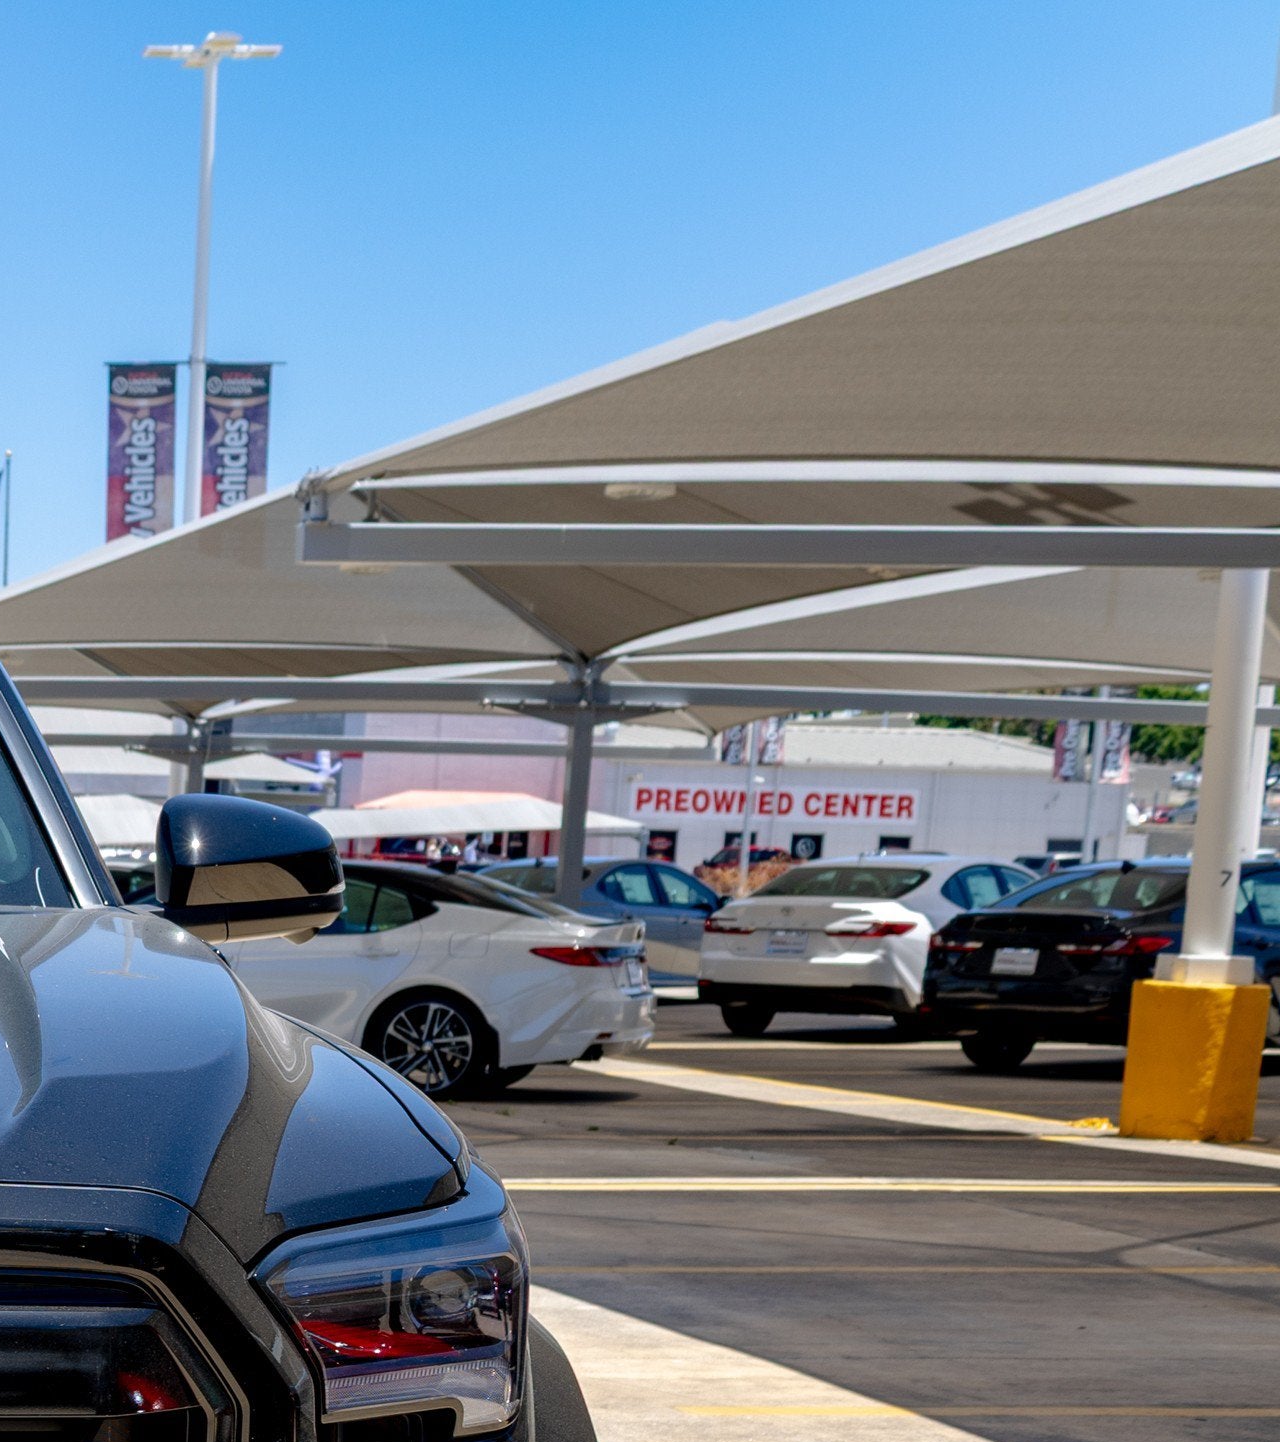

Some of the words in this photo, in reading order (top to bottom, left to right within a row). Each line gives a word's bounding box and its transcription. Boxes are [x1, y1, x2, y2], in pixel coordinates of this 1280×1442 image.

[124, 417, 156, 524] Vehicles
[803, 792, 914, 819] CENTER
[1220, 870, 1233, 887] 7
